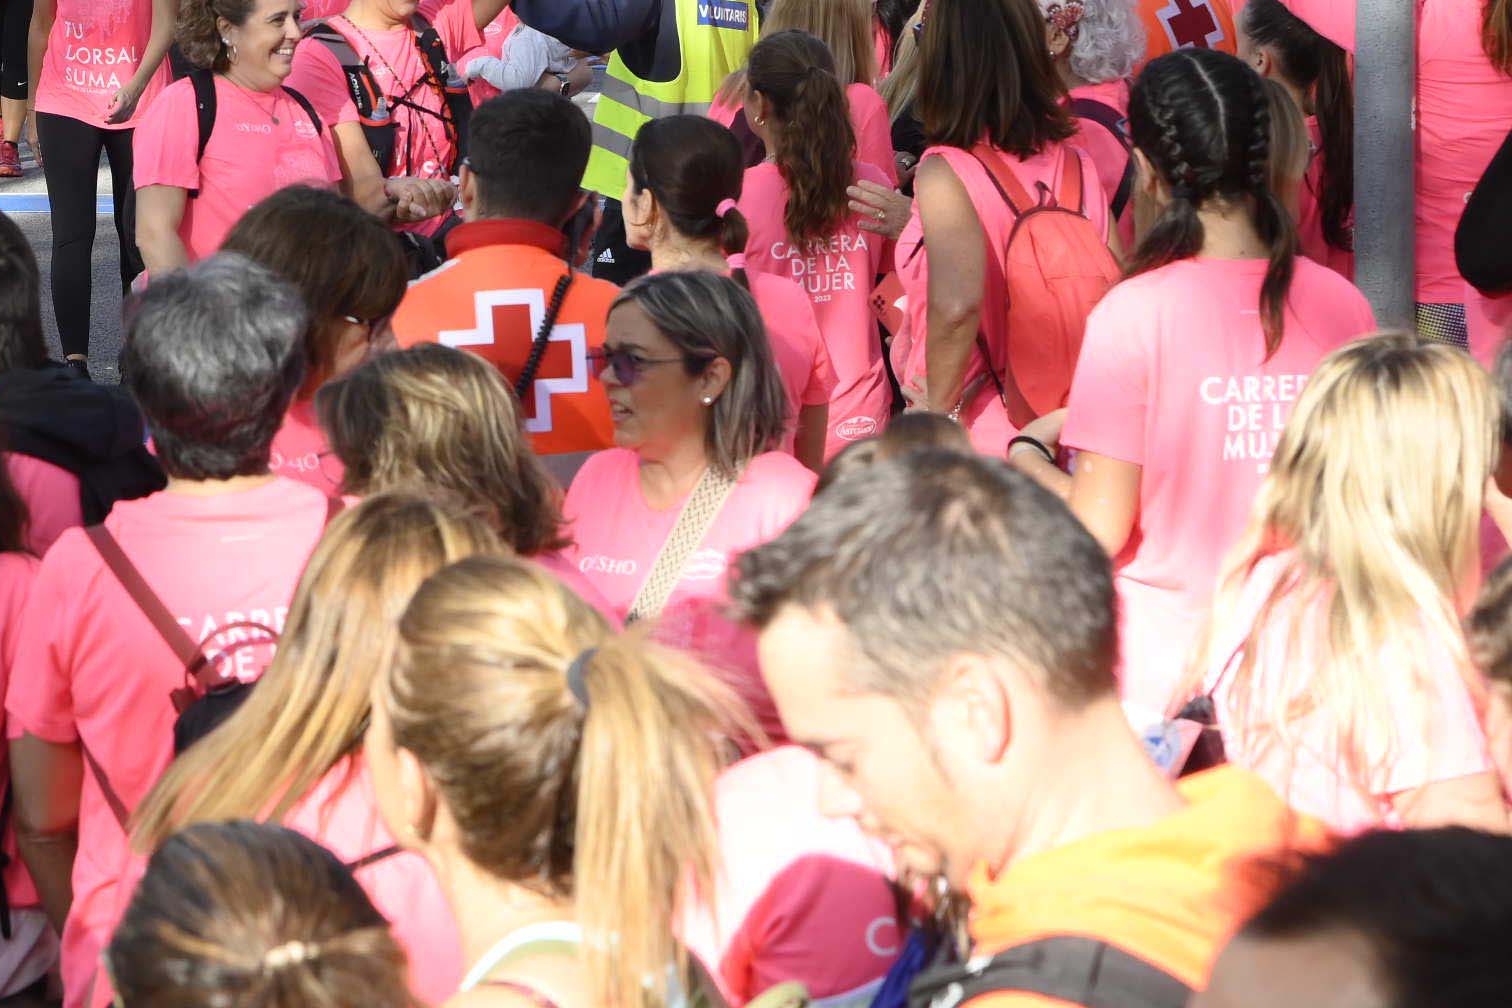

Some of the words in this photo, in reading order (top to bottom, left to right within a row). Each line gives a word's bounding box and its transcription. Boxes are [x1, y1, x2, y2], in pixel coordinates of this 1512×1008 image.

[65, 21, 84, 39] TU
[65, 67, 122, 89] SUMA
[771, 233, 868, 260] CARRERA
[791, 258, 817, 276] DE
[825, 255, 850, 273] LA
[1227, 404, 1263, 432] DE
